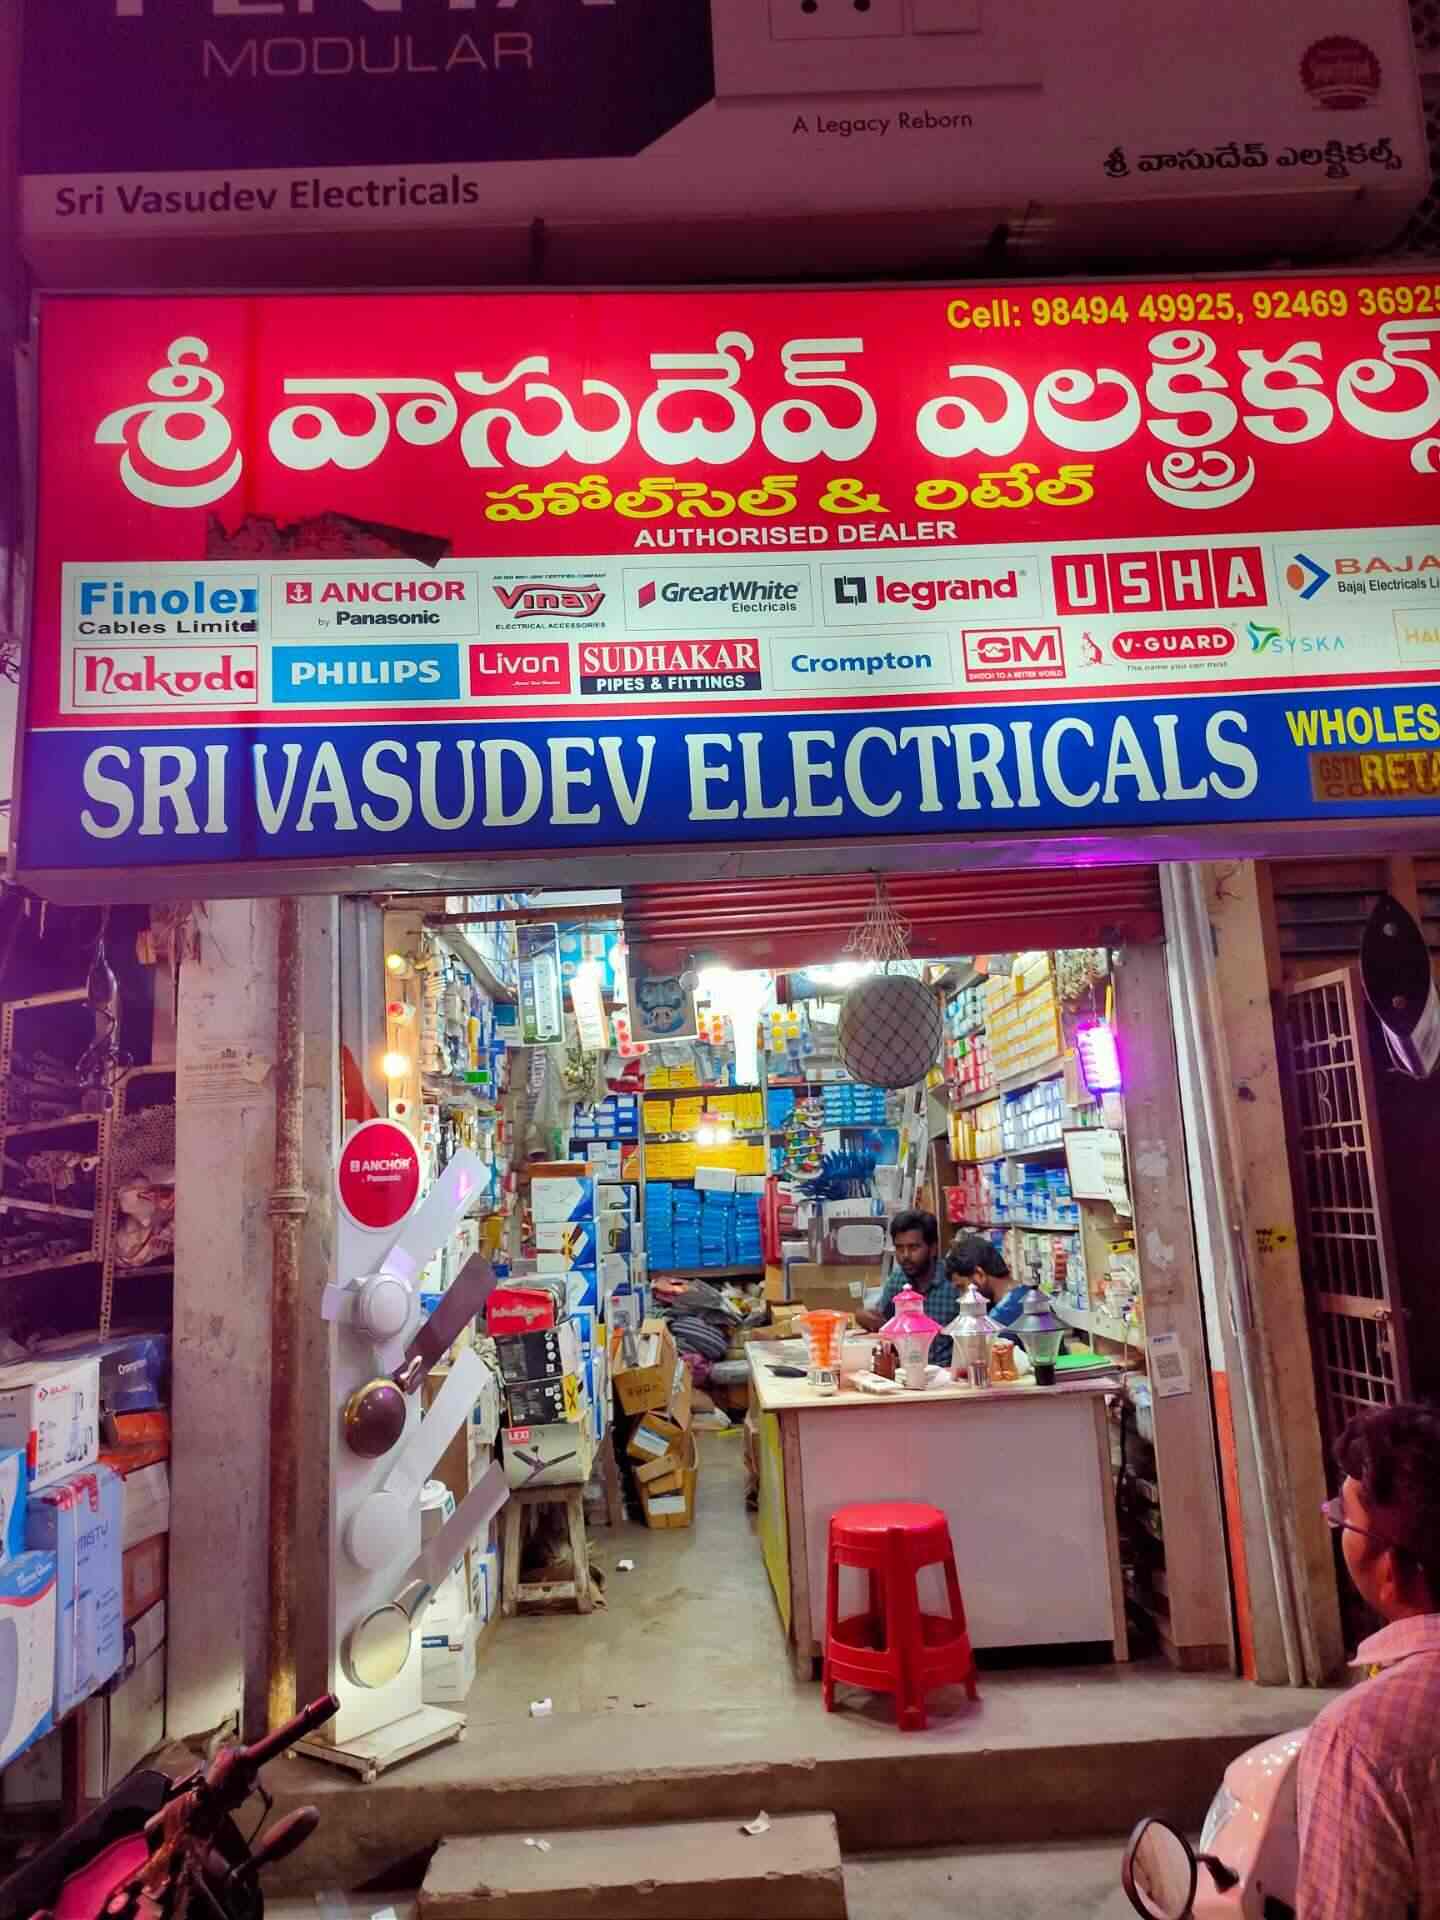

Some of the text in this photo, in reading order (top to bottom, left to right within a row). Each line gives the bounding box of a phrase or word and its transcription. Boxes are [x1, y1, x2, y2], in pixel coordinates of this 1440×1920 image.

[203, 32, 533, 78] MODULAR
[793, 110, 972, 137] A Legacy Reborn
[56, 175, 479, 217] Sri Vasudev Electricals
[947, 299, 1021, 329] Cell:
[1031, 296, 1129, 326] 98494
[1138, 293, 1244, 325] 49925,
[1253, 289, 1347, 319] 92469
[94, 336, 243, 508] శ్రీ
[268, 330, 877, 471] వాసుదేవ్
[819, 478, 890, 515] &
[634, 520, 958, 549] AUTHORISED DEALER
[320, 581, 465, 603] ANCHOR
[876, 570, 1018, 611] legrand
[1063, 555, 1257, 608] USHA
[1338, 581, 1367, 595] Bajaj
[1369, 577, 1427, 592] Electricals
[493, 582, 606, 618] Vinay
[731, 601, 797, 613] Electricals
[78, 621, 166, 635] Cables
[336, 610, 440, 626] Panasonic
[977, 635, 1057, 663] GM
[1119, 634, 1228, 653] V-GUARD
[1271, 636, 1344, 654] SYSKA
[479, 652, 560, 675] Livon
[583, 643, 758, 673] SUDHAKAR
[791, 652, 932, 674] Crompton
[291, 660, 441, 685] PHILIPS
[597, 674, 745, 692] PIPES & FITTINGS
[81, 710, 1260, 839] SRI VASUDEV ELECTRICALS
